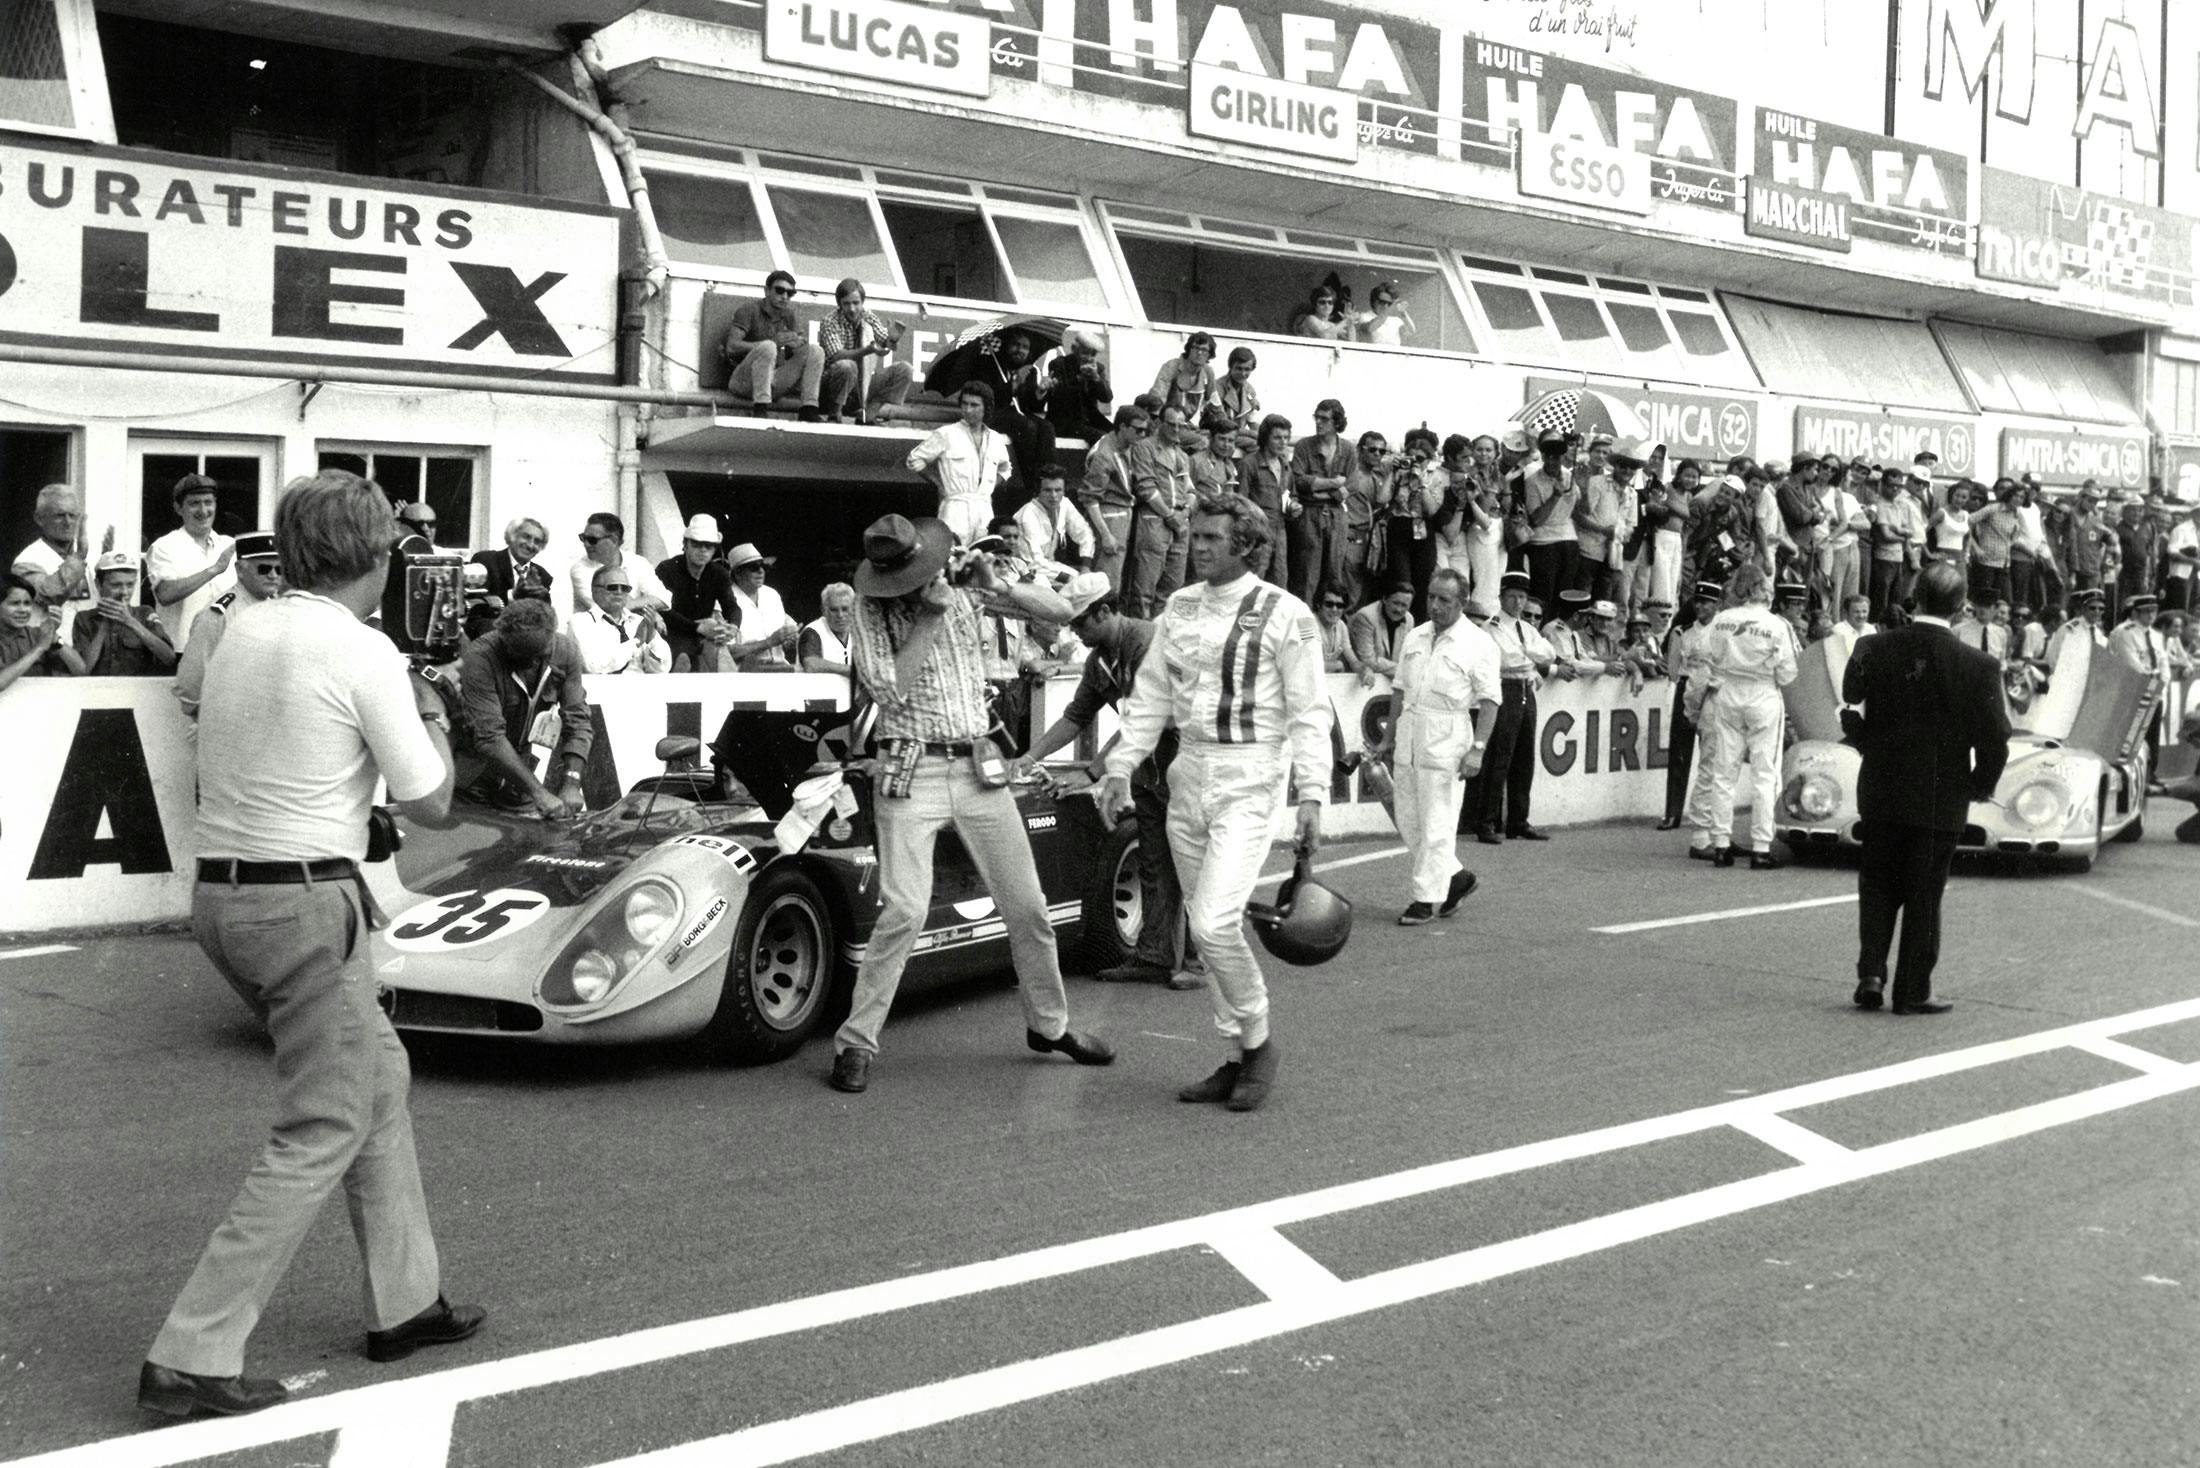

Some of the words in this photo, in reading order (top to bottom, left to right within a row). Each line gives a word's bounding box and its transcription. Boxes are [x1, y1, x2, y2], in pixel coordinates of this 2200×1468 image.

[801, 2, 960, 69] LUCAS
[1107, 0, 1411, 96] HAFA
[1477, 42, 1543, 77] HUILE
[1210, 84, 1338, 139] GIRLING
[1923, 0, 2200, 173] MA
[1487, 76, 1714, 160] HAFA
[1765, 112, 1817, 141] HUILE
[1772, 140, 1950, 210] HAFA
[0, 161, 472, 249] URATEURS
[1753, 187, 1850, 241] MARCHAL
[1980, 223, 2060, 282] TRICO
[0, 225, 573, 357] LEX
[1722, 413, 1747, 446] 32
[1950, 433, 1966, 464] 31
[2122, 453, 2138, 475] 30
[1715, 622, 1737, 632] GOOD
[1749, 626, 1772, 638] YEAR
[1027, 815, 1057, 829] FERODO
[526, 854, 606, 868] Firestone
[393, 891, 543, 944] 35
[682, 920, 707, 946] BORG
[706, 898, 727, 921] BECK
